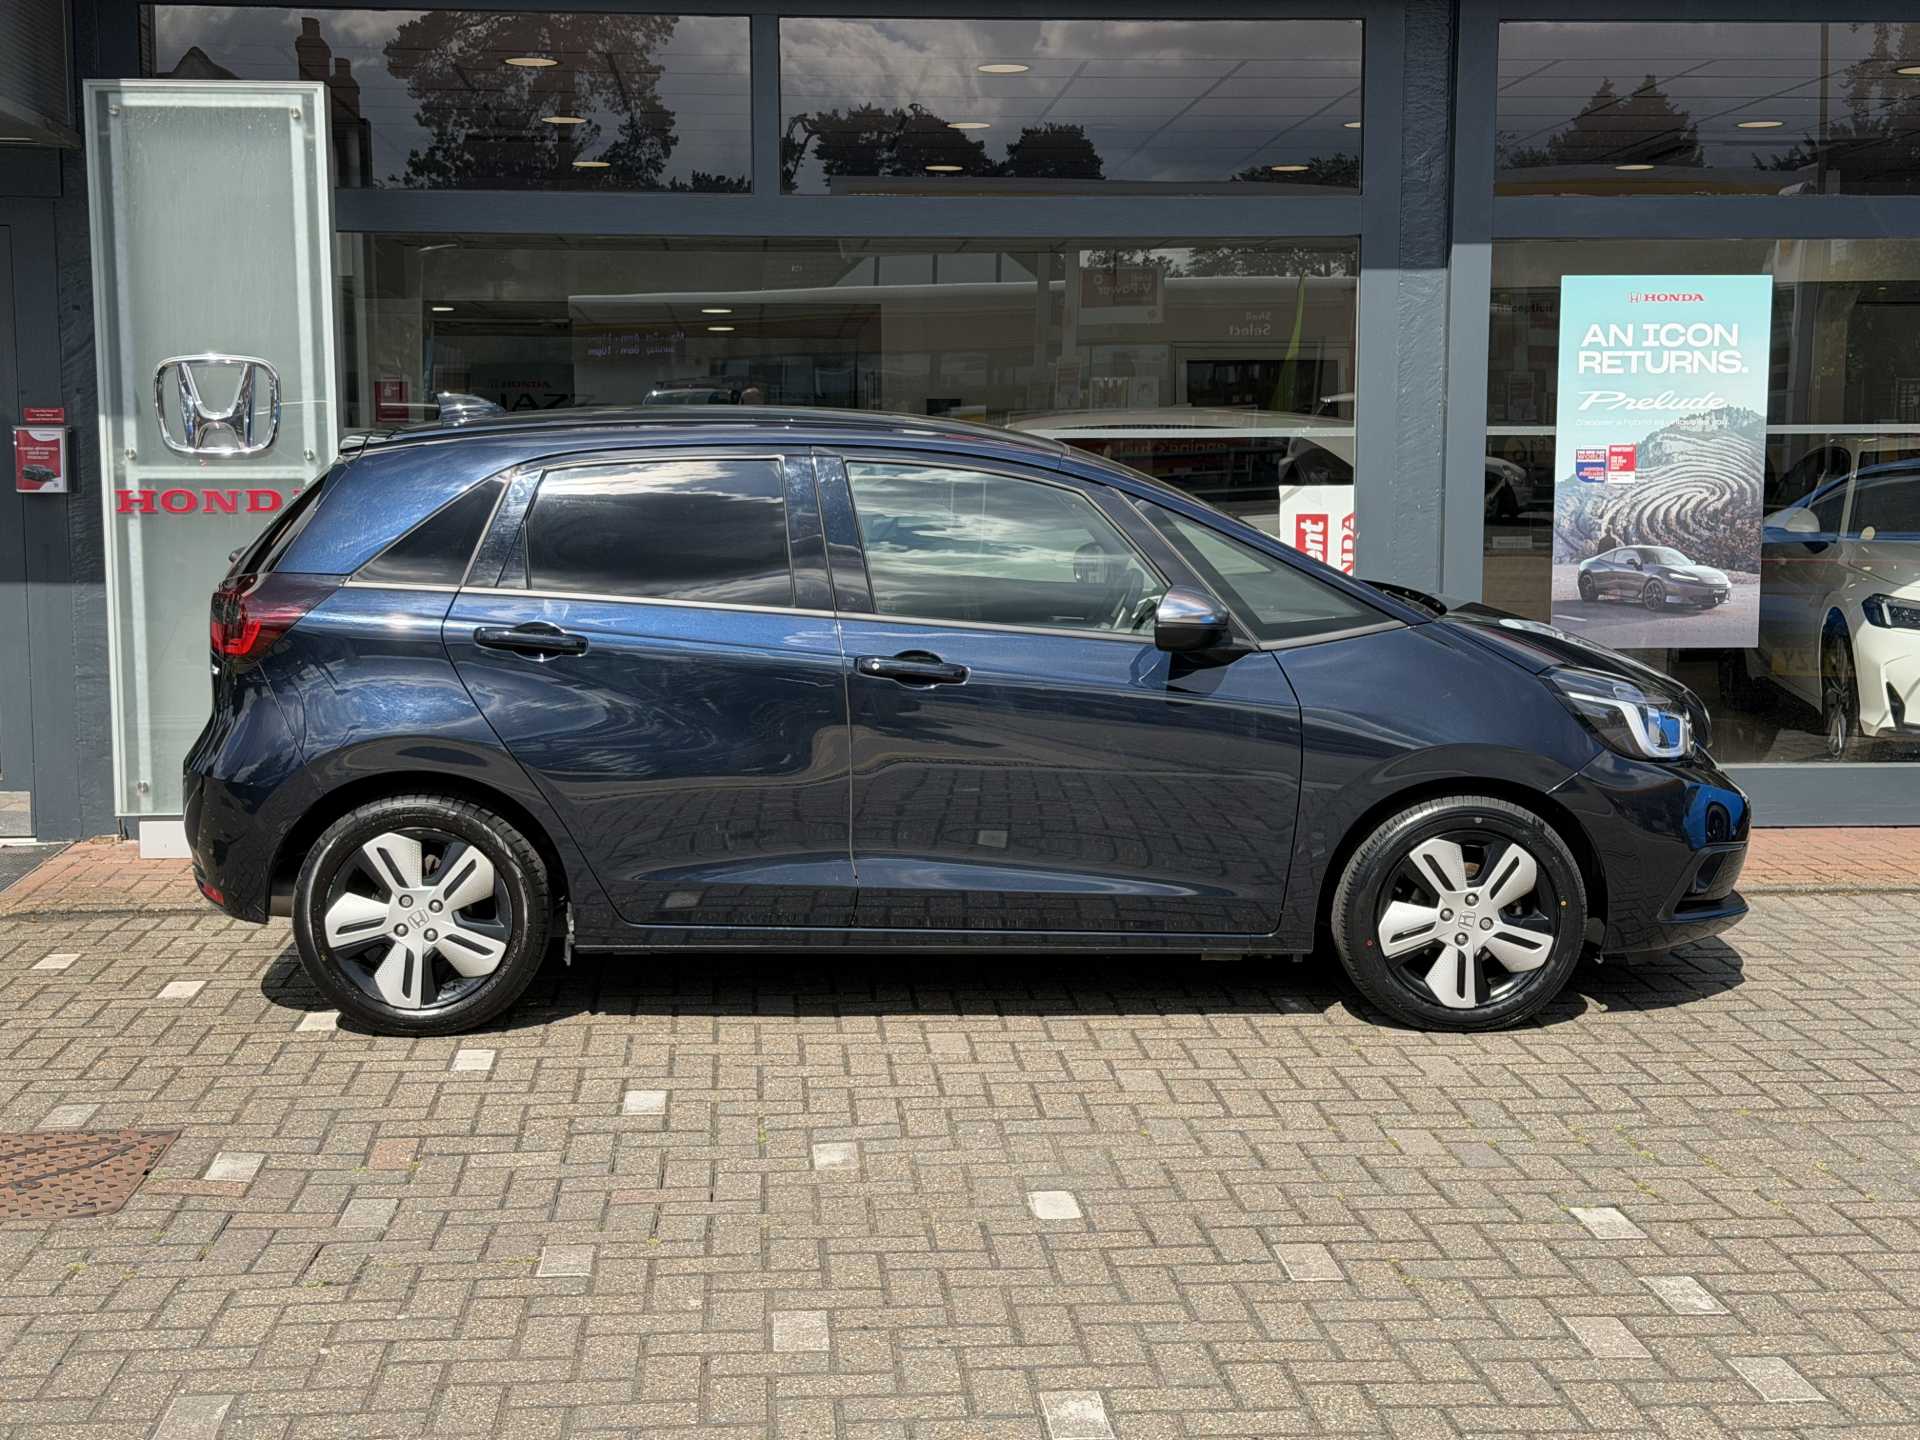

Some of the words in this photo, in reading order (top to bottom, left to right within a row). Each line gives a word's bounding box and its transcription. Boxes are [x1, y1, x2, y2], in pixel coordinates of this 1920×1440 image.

[1643, 293, 1705, 303] HONDA
[1580, 323, 1634, 347] AN
[1642, 323, 1739, 347] ICON
[1577, 350, 1750, 375] RETURNS.
[1578, 390, 1727, 411] Prelude
[114, 488, 301, 513] HOND
